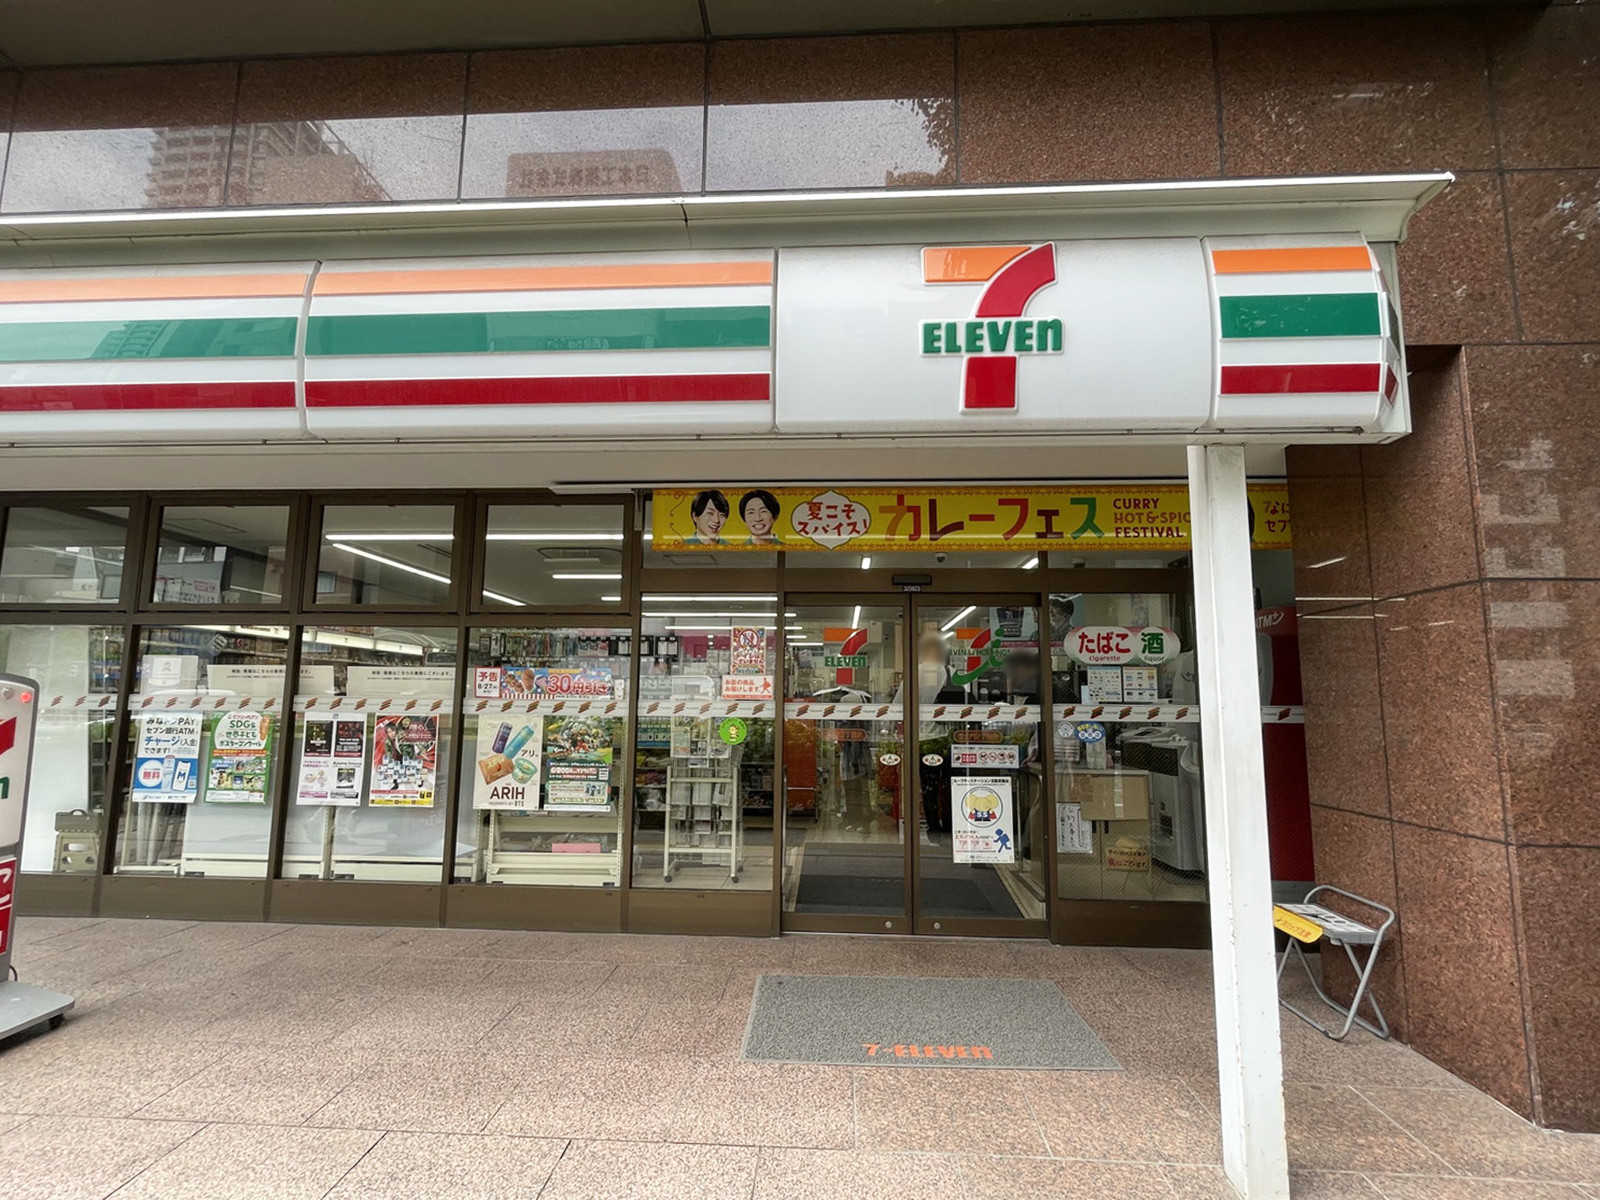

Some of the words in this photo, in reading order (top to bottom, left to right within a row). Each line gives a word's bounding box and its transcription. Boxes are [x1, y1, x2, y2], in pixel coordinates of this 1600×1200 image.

[1112, 498, 1160, 510] CURRY
[806, 502, 856, 521] 夏こそ
[878, 494, 1105, 542] カレーフェス
[1114, 526, 1185, 538] FESTIVAL
[1078, 631, 1131, 655] たばこ
[1140, 632, 1165, 655] 酒
[478, 671, 498, 682] 予告
[489, 786, 526, 800] ARIH
